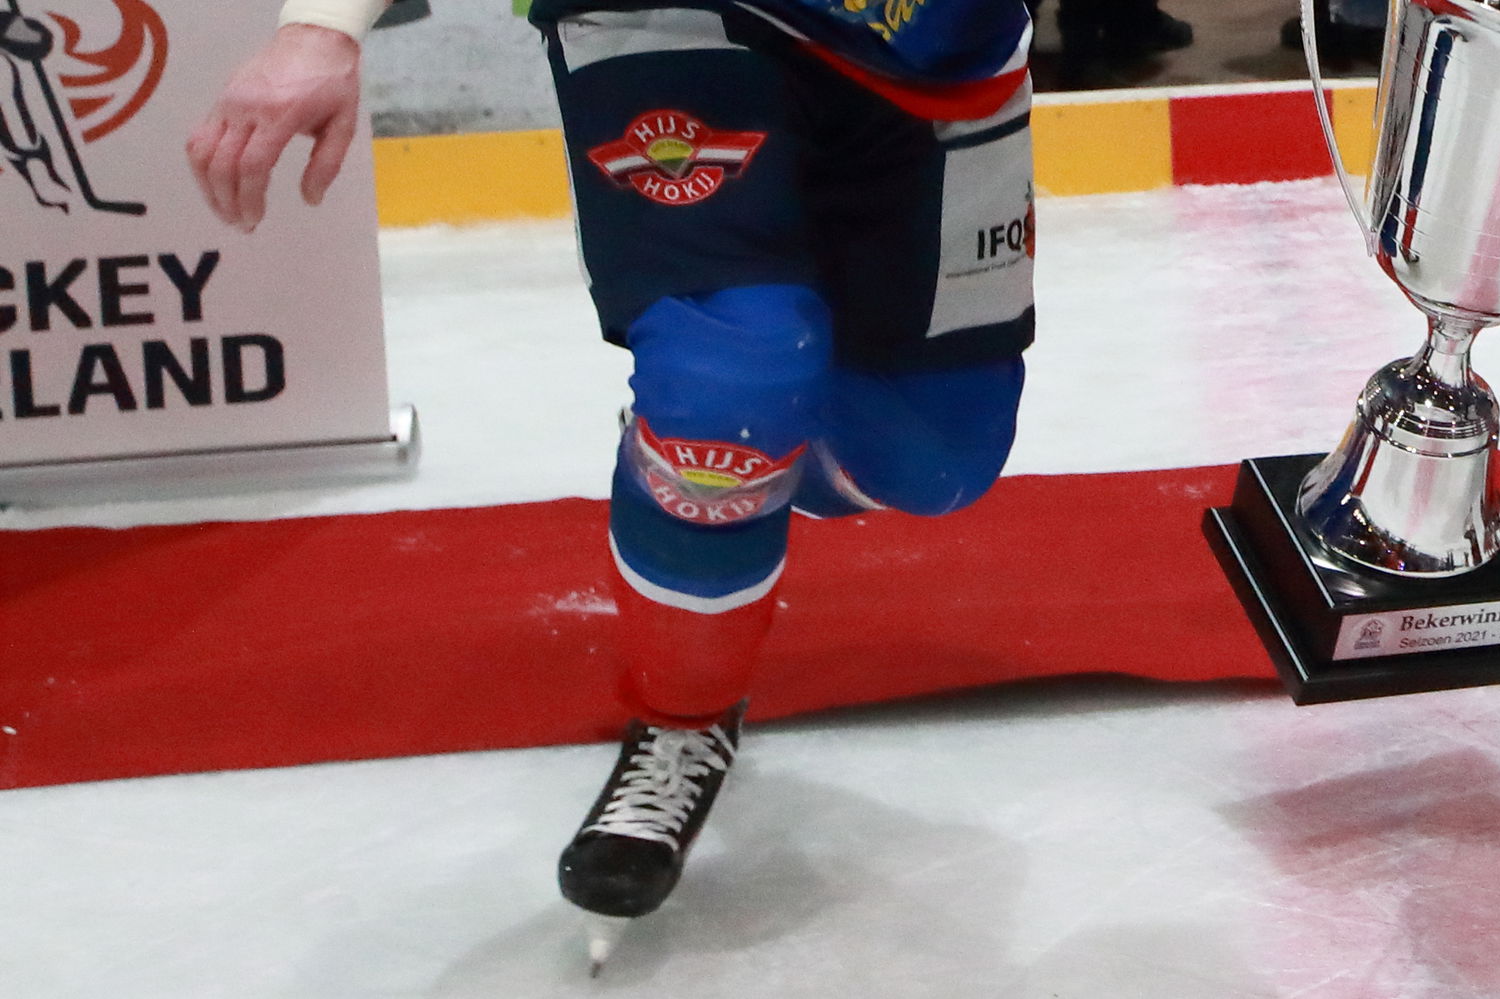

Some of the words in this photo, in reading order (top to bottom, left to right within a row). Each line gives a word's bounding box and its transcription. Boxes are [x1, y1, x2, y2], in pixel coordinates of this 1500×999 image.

[635, 115, 700, 143] HIJS
[643, 172, 715, 200] HOKIJ
[0, 333, 286, 423] LAND
[675, 446, 762, 475] HIJS
[655, 486, 756, 521] HOKIJ
[1399, 635, 1452, 649] Seizoen
[1455, 630, 1487, 643] 2021
